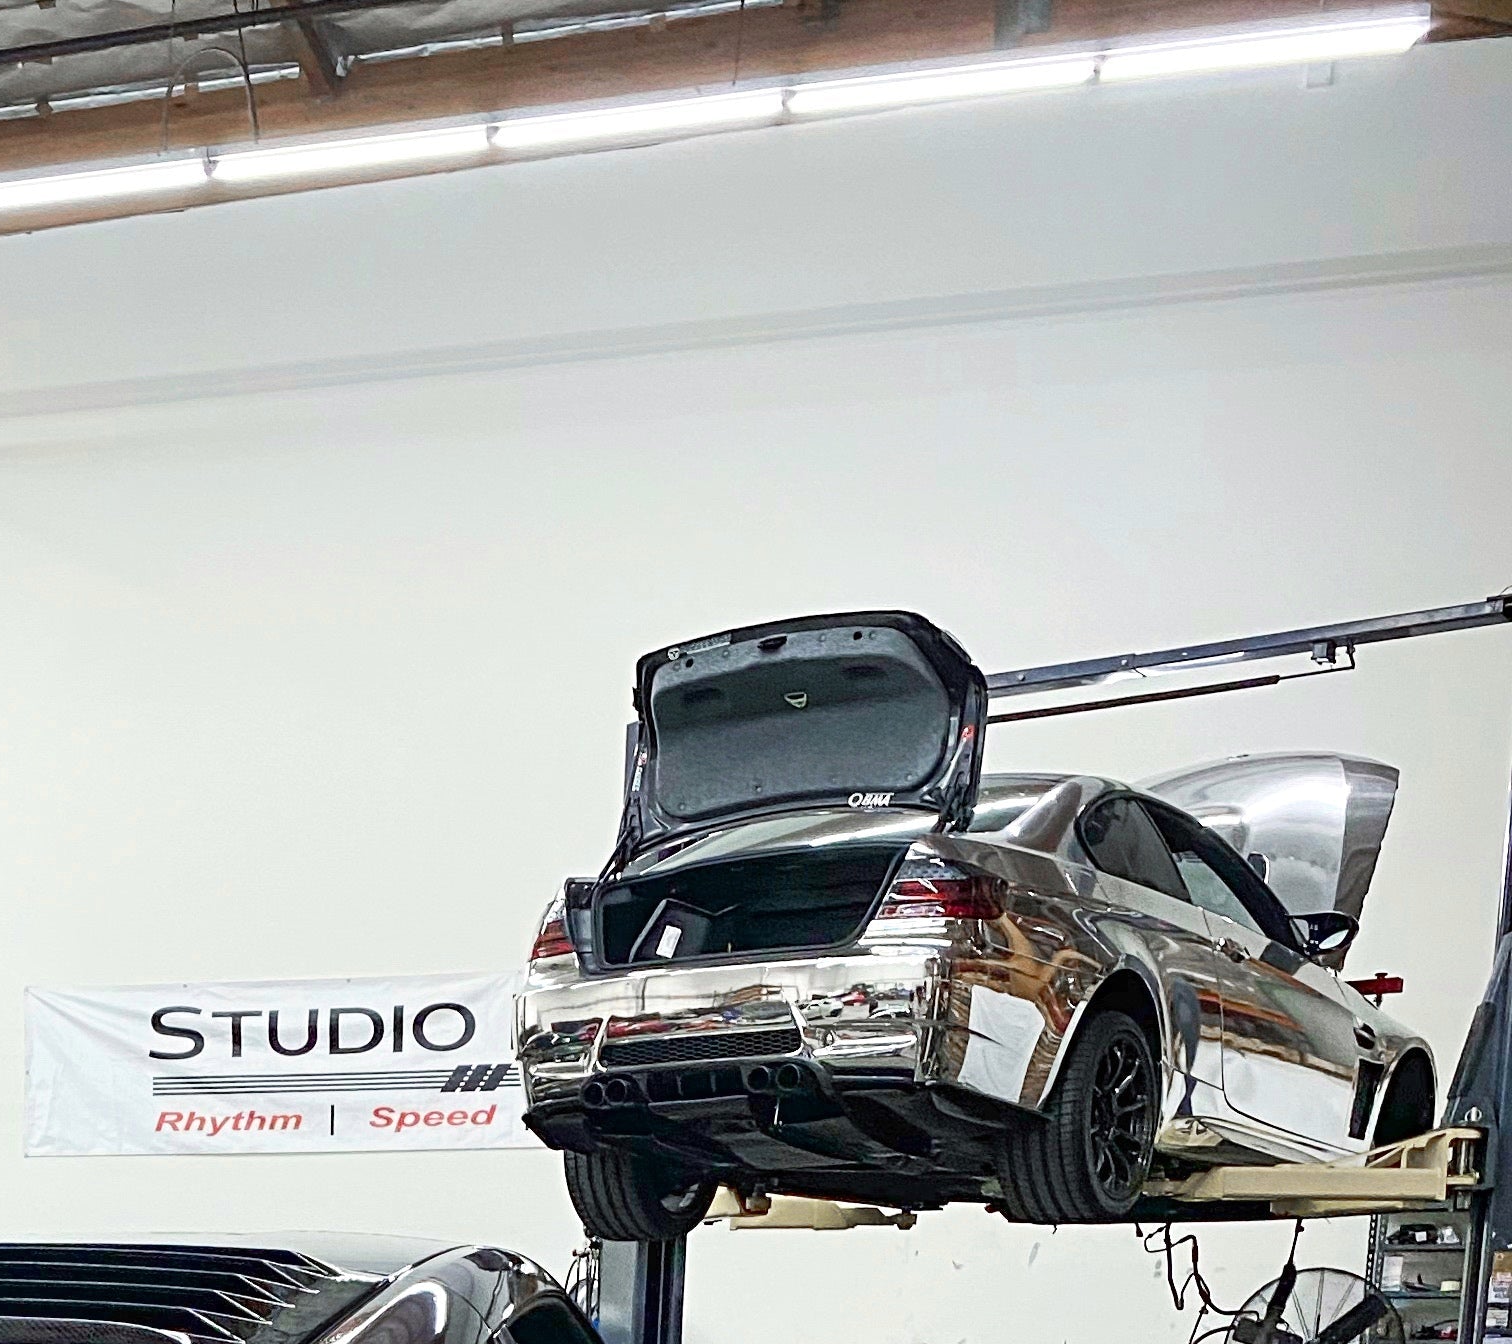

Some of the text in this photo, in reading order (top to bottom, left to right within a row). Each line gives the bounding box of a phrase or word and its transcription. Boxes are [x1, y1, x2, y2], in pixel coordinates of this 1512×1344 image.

[148, 1003, 476, 1060] STUDIO
[154, 1104, 497, 1132] Rhythm Speed
